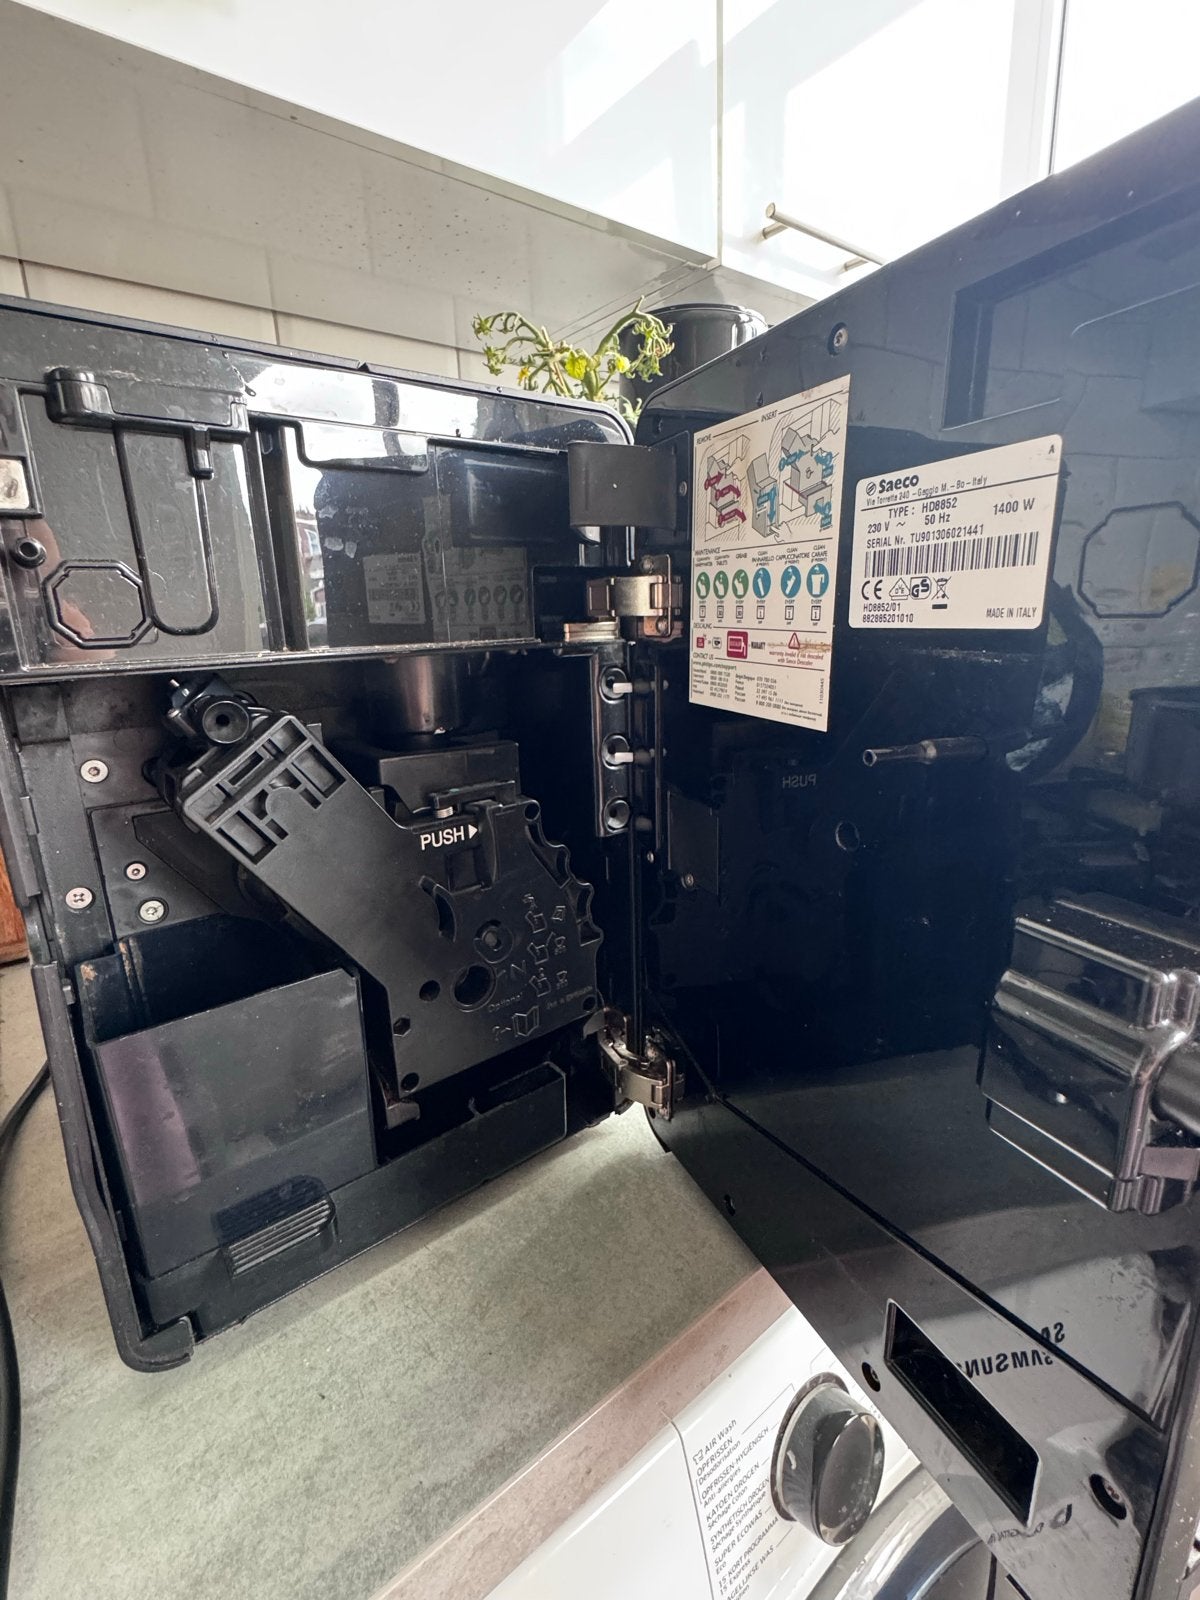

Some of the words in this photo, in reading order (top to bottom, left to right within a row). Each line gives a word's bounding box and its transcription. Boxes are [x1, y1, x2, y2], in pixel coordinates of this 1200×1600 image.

[1049, 444, 1055, 454] A
[866, 498, 876, 506] Via
[972, 476, 988, 488] Italy
[879, 474, 919, 494] Saeco
[888, 506, 908, 519] TYPE
[922, 497, 958, 514] HD8852
[993, 500, 1018, 516] 1400
[1022, 498, 1036, 510] W
[868, 524, 882, 534] 230
[884, 522, 890, 532] V
[924, 514, 936, 526] 50
[938, 512, 950, 523] Hz
[867, 538, 892, 548] SERIAL
[895, 536, 906, 546] Nr.
[863, 602, 901, 612] HD8852/01
[986, 609, 1004, 618] MADE
[1006, 608, 1015, 617] IN
[1016, 607, 1036, 617] ITALY
[420, 826, 464, 850] PUSH
[705, 1438, 717, 1454] AIR
[718, 1420, 736, 1440] Wash
[696, 1437, 732, 1476] OPFRISSEN
[706, 1491, 733, 1522] KATOEN
[734, 1461, 760, 1492] DROGEN
[732, 1486, 747, 1504] Coton
[710, 1502, 747, 1544] SYNTHETISCH
[714, 1540, 736, 1566] SUPER
[736, 1509, 762, 1542] ECOWAS
[728, 1556, 744, 1578] KORT
[744, 1516, 778, 1560] PROGRAMMA
[760, 1544, 774, 1564] WAS
[716, 1561, 726, 1575] Eco
[730, 1559, 750, 1586] Express
